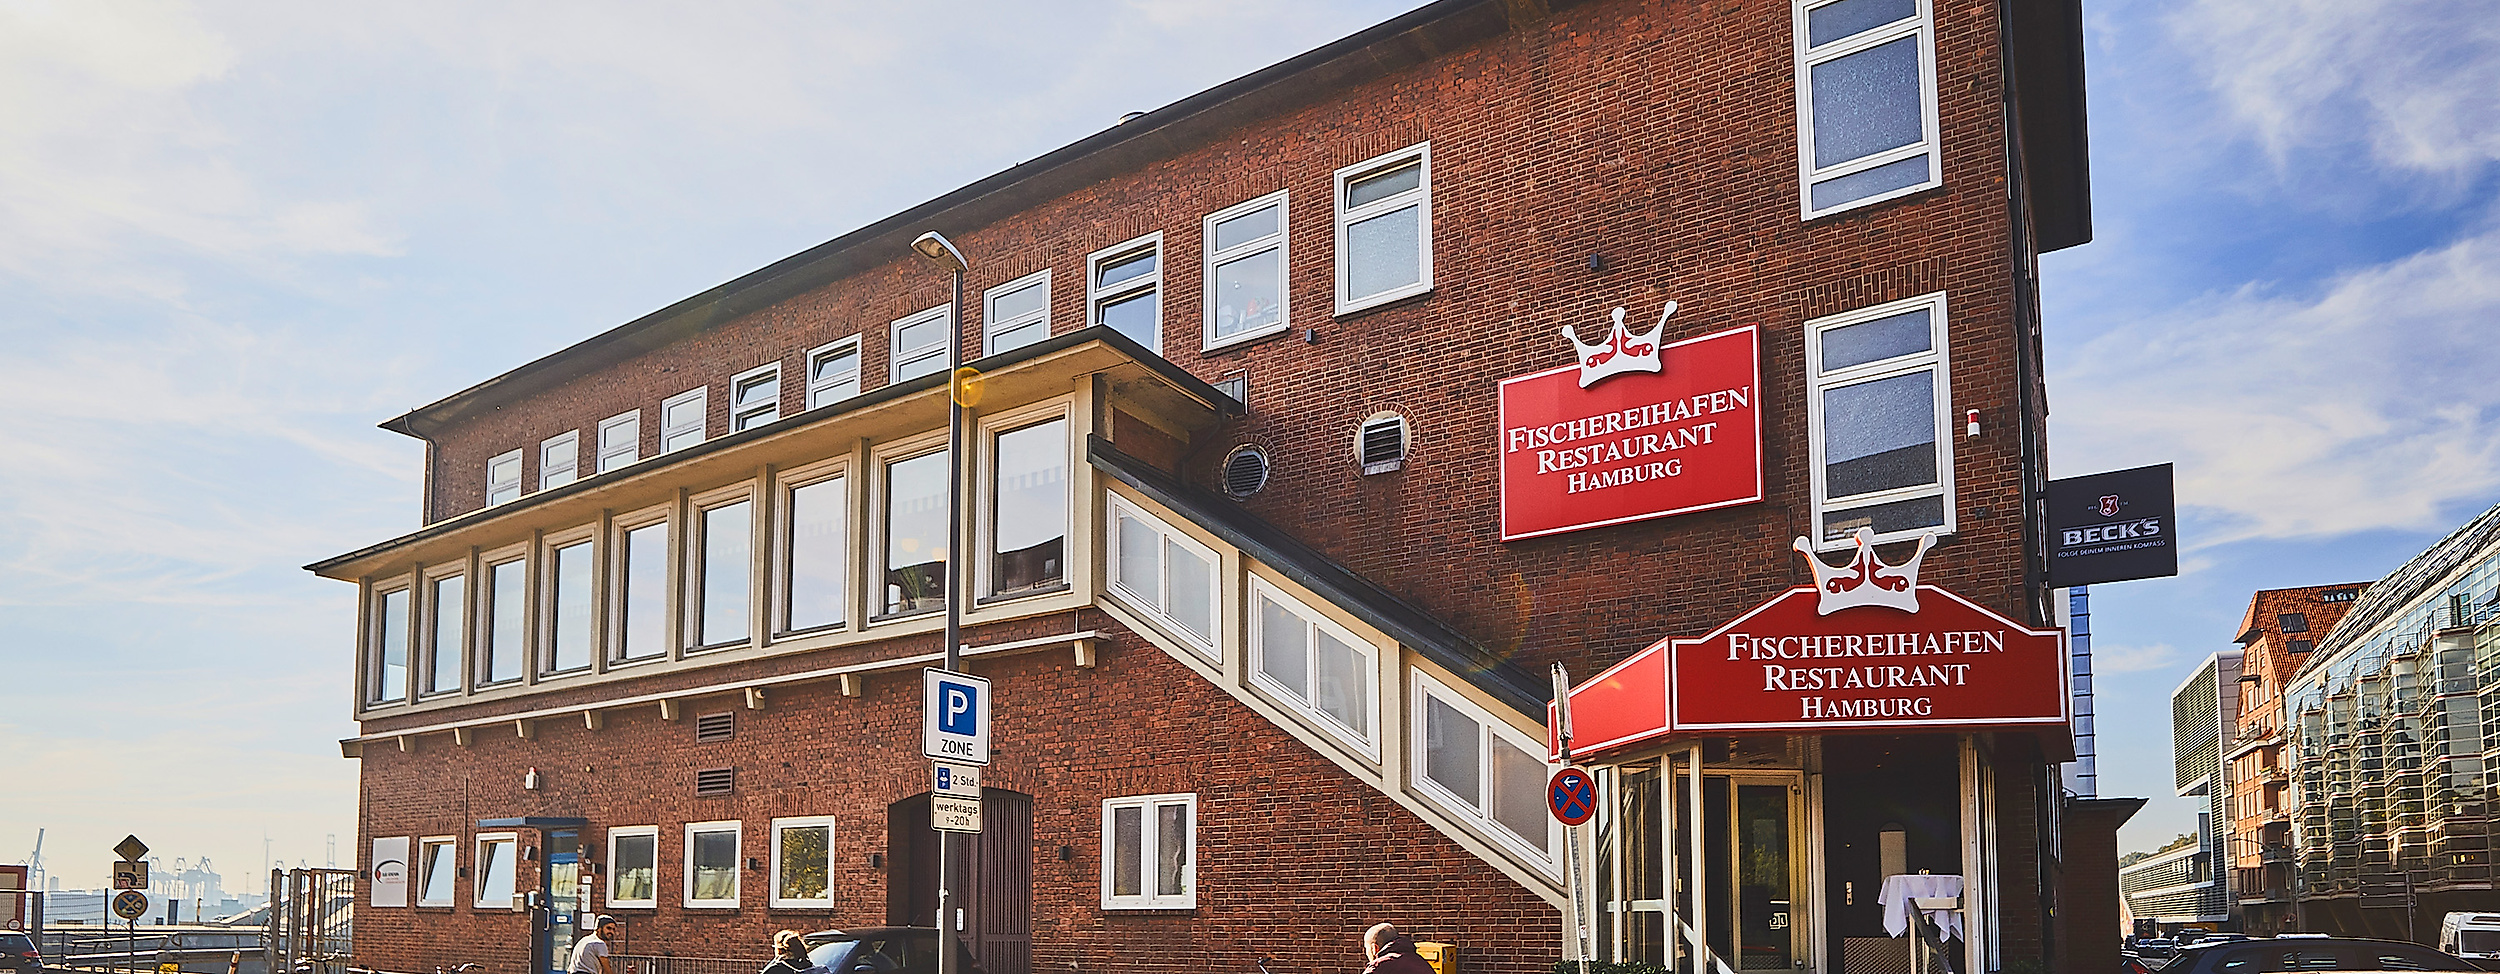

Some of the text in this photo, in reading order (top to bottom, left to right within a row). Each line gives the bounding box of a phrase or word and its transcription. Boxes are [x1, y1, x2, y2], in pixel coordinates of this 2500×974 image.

[1508, 386, 1750, 453] FISCHEREIHAFEN
[1536, 422, 1717, 475] RESTAURANT
[1567, 458, 1682, 494] HAMBURG
[2062, 518, 2160, 546] BECK'S
[2057, 539, 2166, 558] FOLGE DEINEM INNEREN KOMPASS
[1726, 630, 2005, 661] FISCHEREIHAFEN
[1763, 663, 1970, 691] RESTAURANT
[947, 688, 969, 727] P
[1801, 696, 1932, 718] HAMBURG
[941, 738, 974, 757] ZONE
[952, 774, 977, 788] 2 Std.
[936, 802, 978, 817] werktags
